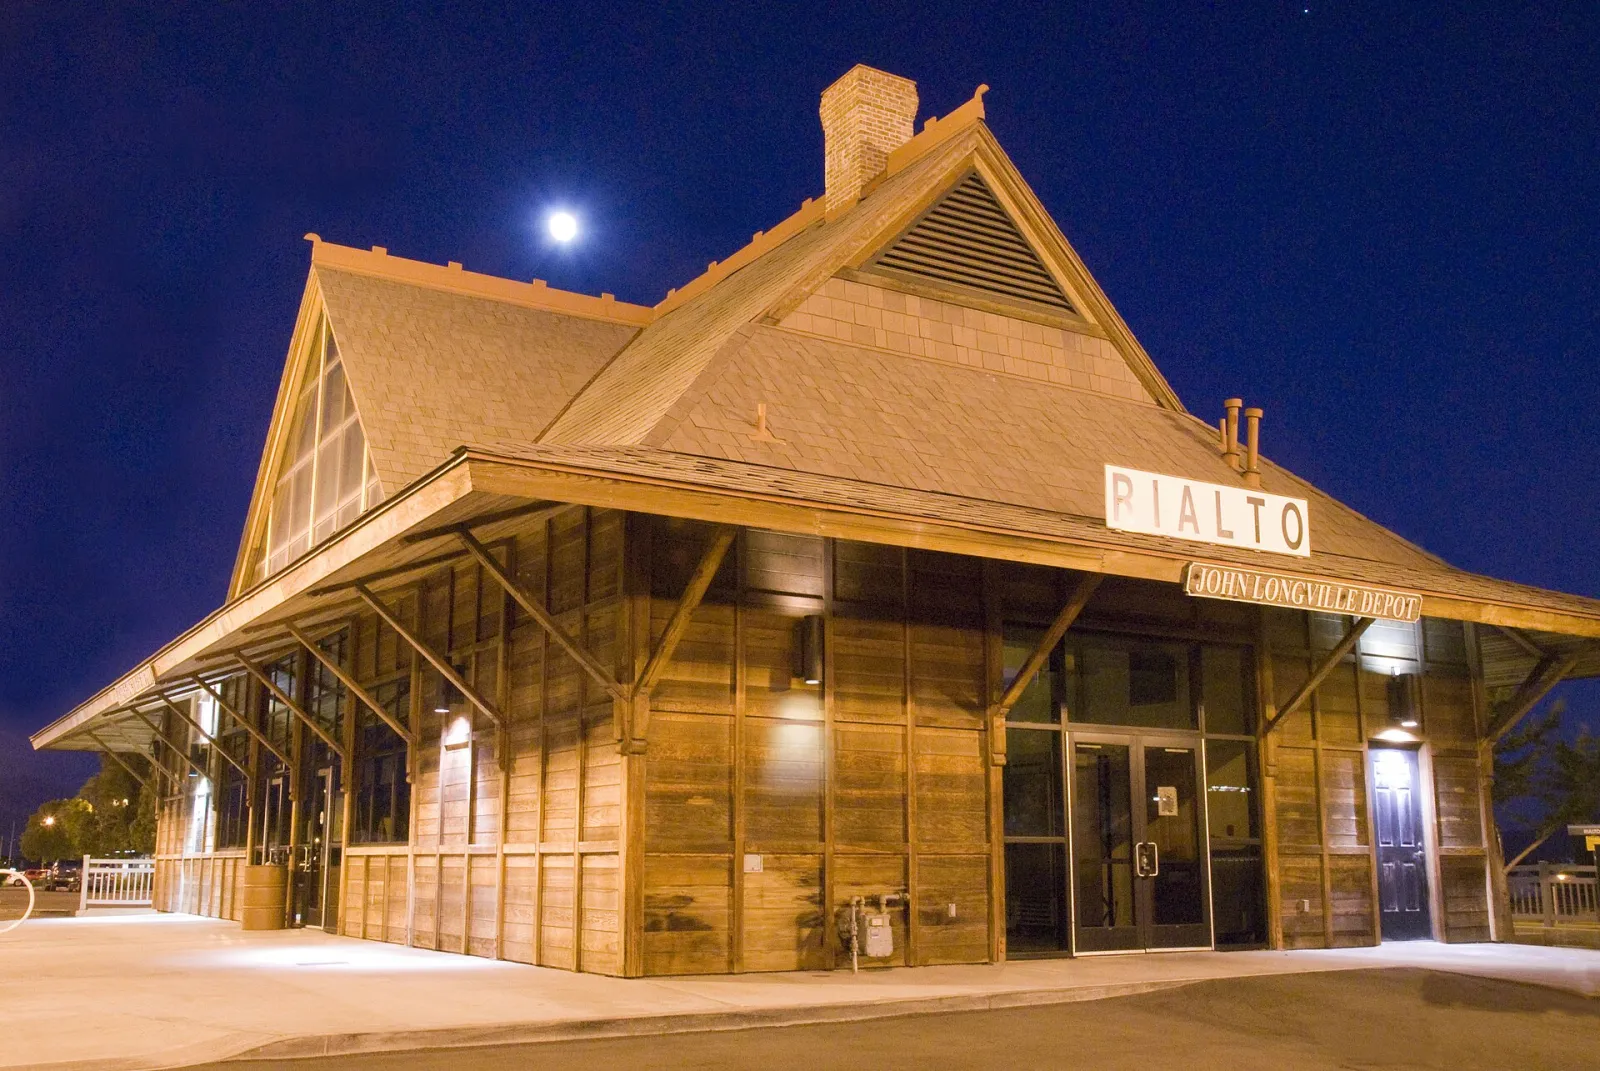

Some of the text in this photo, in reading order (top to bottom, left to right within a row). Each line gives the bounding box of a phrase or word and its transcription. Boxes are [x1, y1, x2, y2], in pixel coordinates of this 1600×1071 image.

[1112, 472, 1304, 551] RIALTO
[1195, 567, 1418, 619] JOHN LONGVILLE DEPOT
